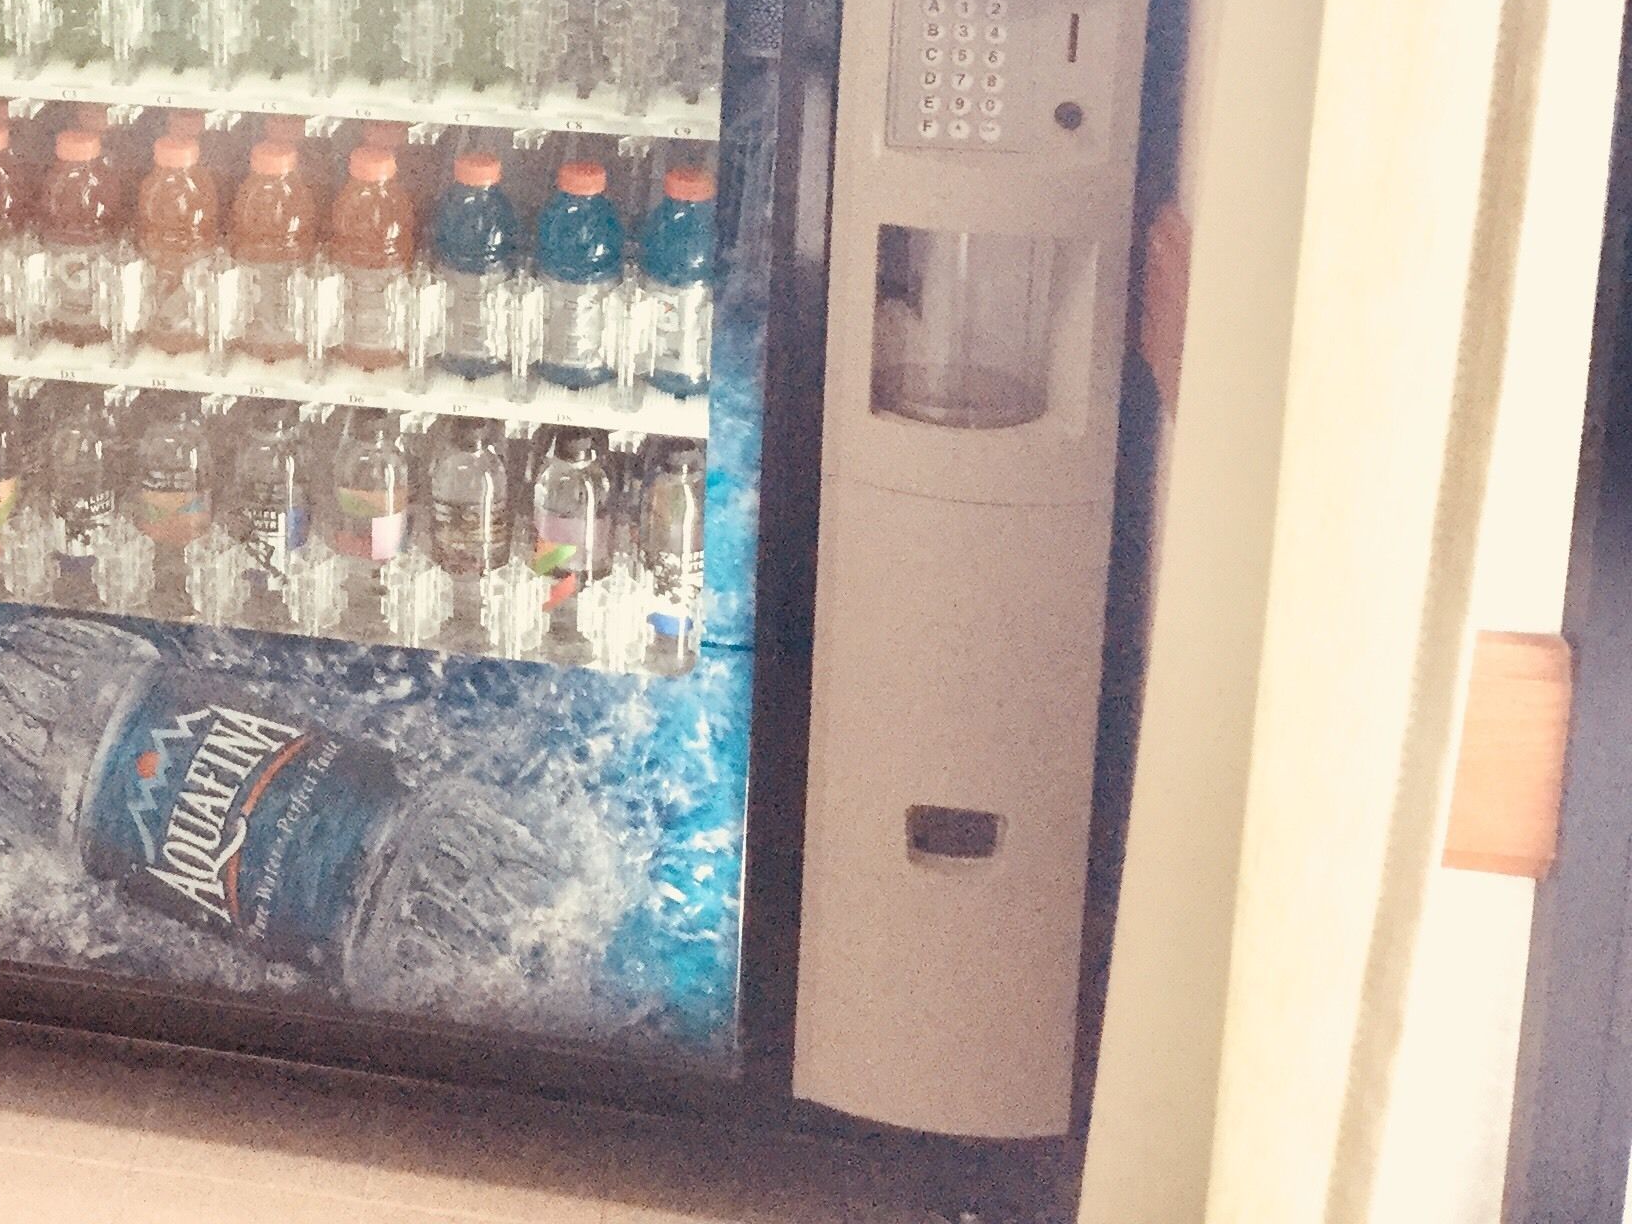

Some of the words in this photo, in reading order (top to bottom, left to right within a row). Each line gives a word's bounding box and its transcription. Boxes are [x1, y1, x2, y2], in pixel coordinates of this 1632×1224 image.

[991, 2, 1001, 15] 2
[959, 25, 968, 37] 3
[925, 48, 938, 61] C
[988, 51, 998, 63] 6
[925, 72, 936, 85] D
[956, 73, 966, 85] 7
[955, 97, 964, 110] 9
[923, 119, 933, 132] F
[276, 777, 319, 833] Perfect
[145, 704, 305, 923] AQUAFINA
